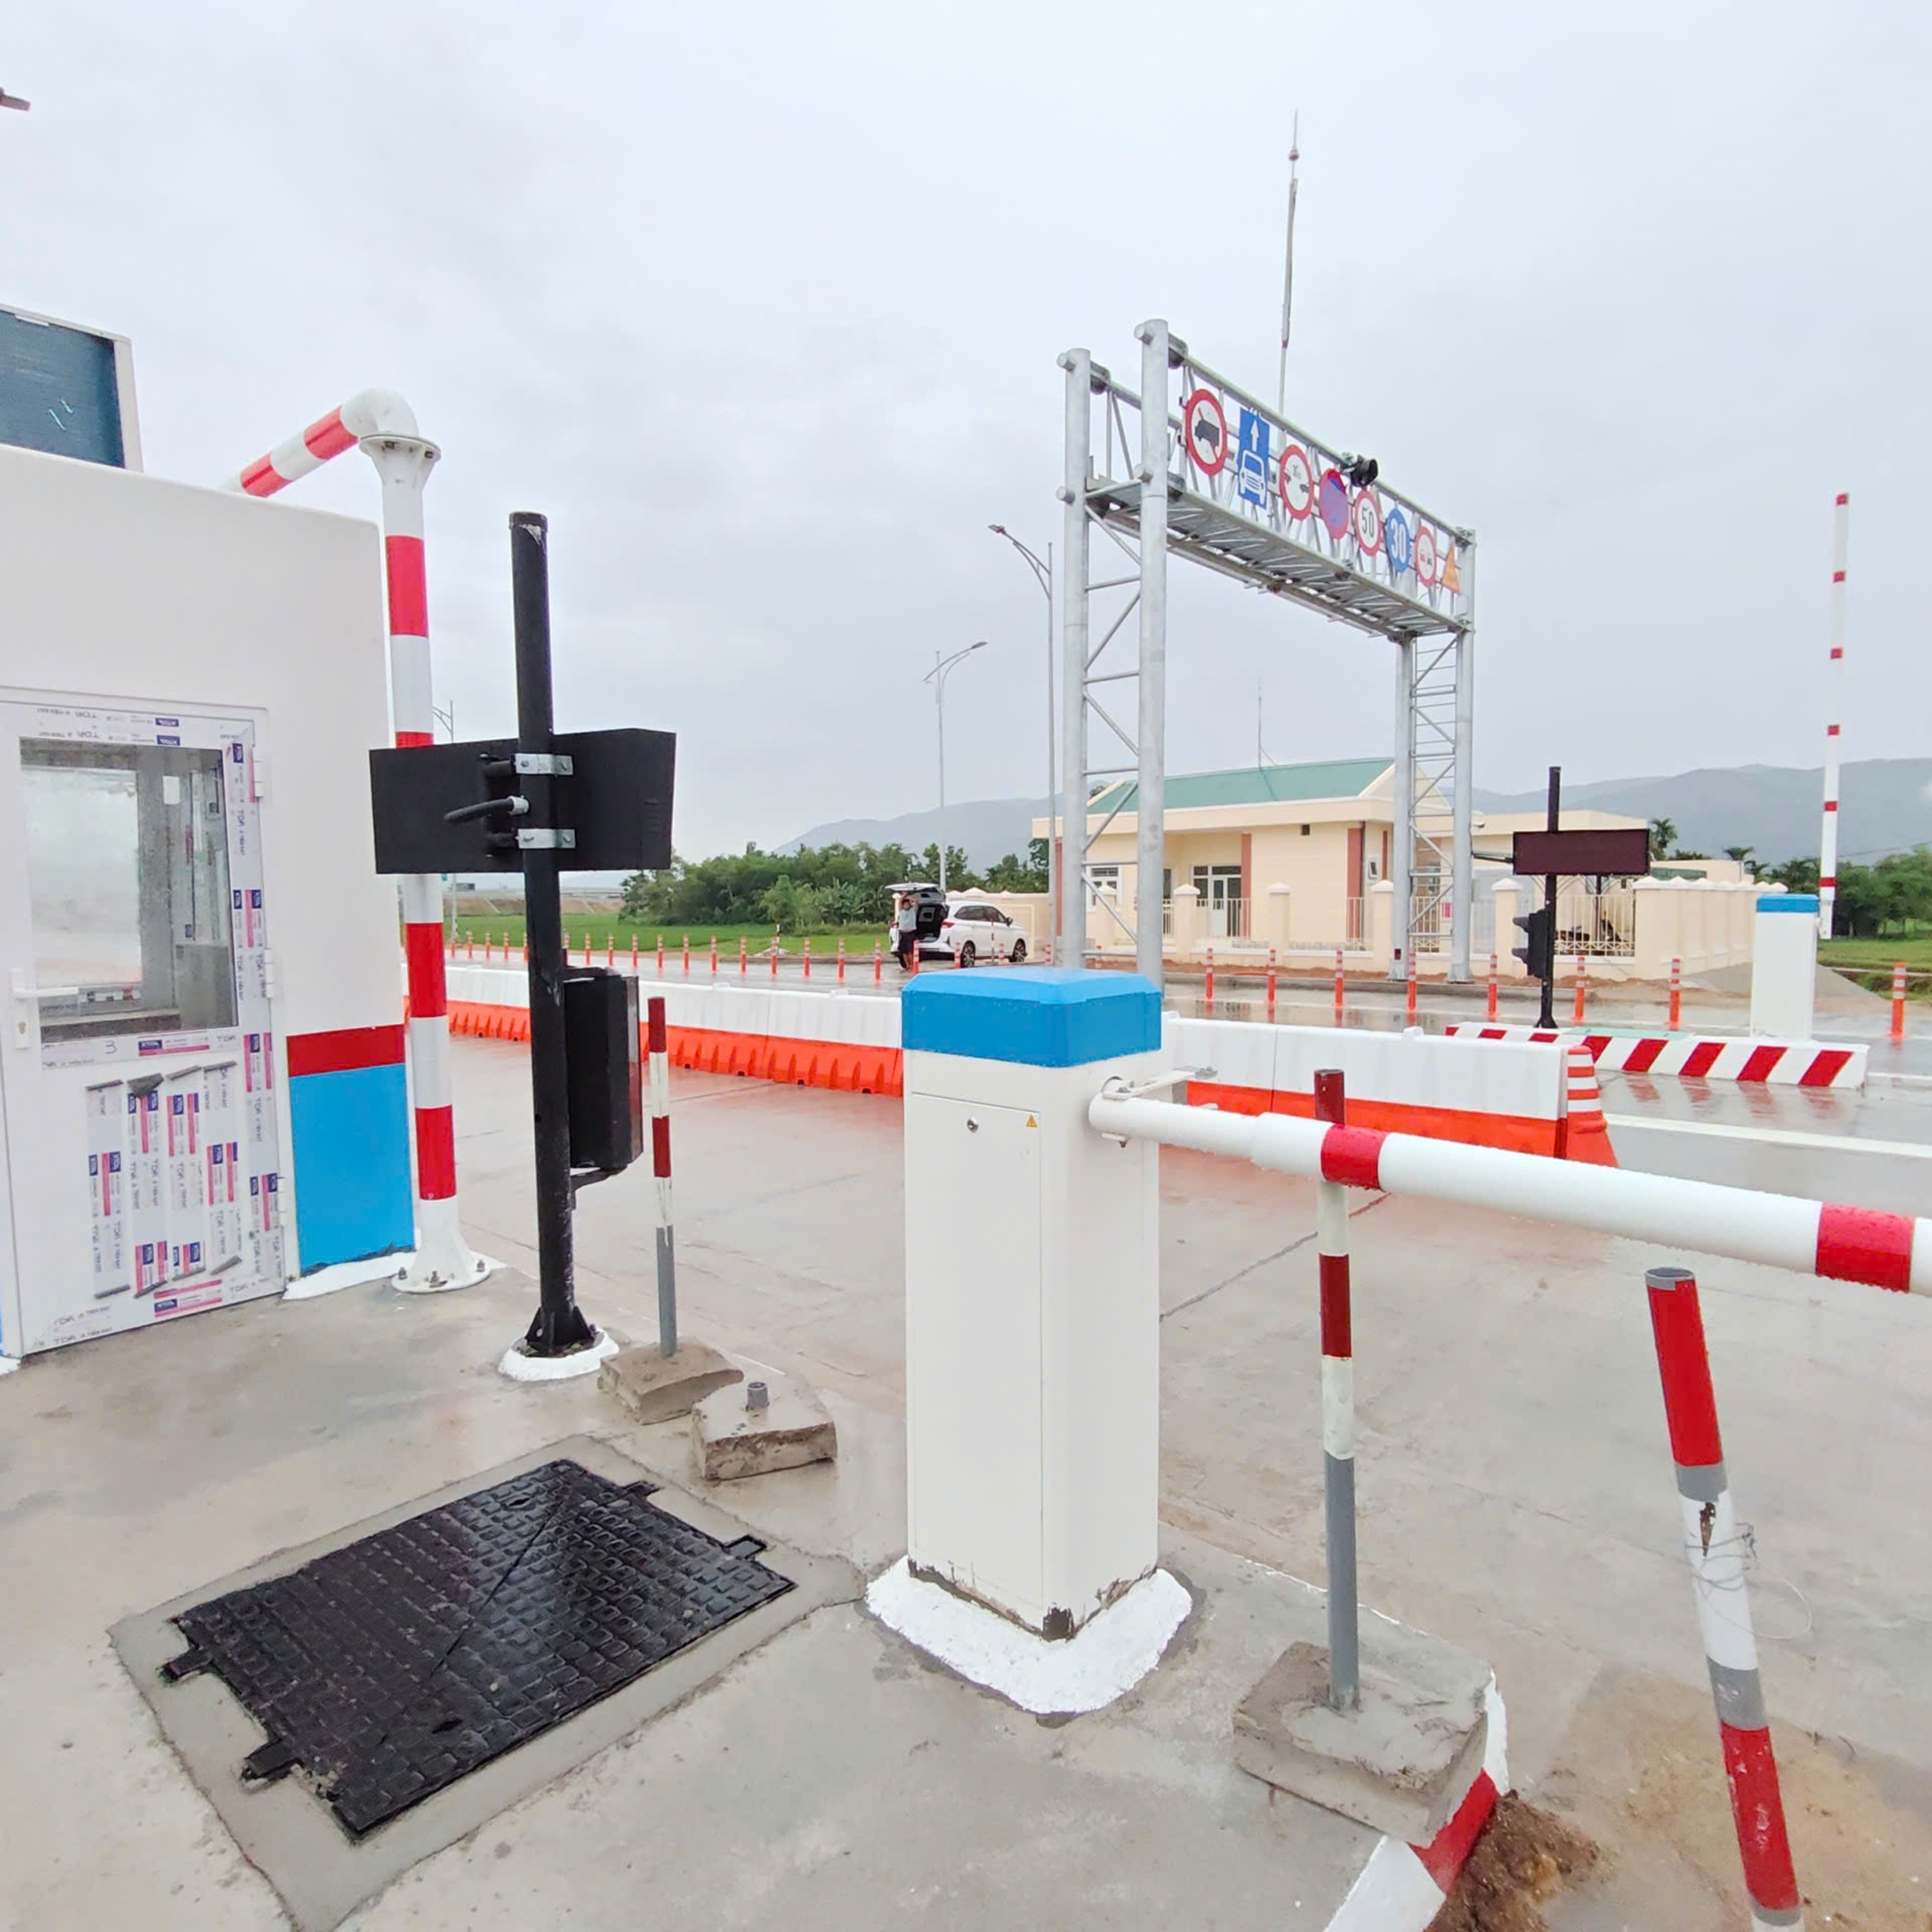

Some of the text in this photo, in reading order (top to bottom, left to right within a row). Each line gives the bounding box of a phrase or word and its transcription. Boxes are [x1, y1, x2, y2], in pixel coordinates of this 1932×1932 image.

[1361, 507, 1375, 538] 50
[1390, 518, 1407, 564] 30
[105, 1039, 117, 1054] 3
